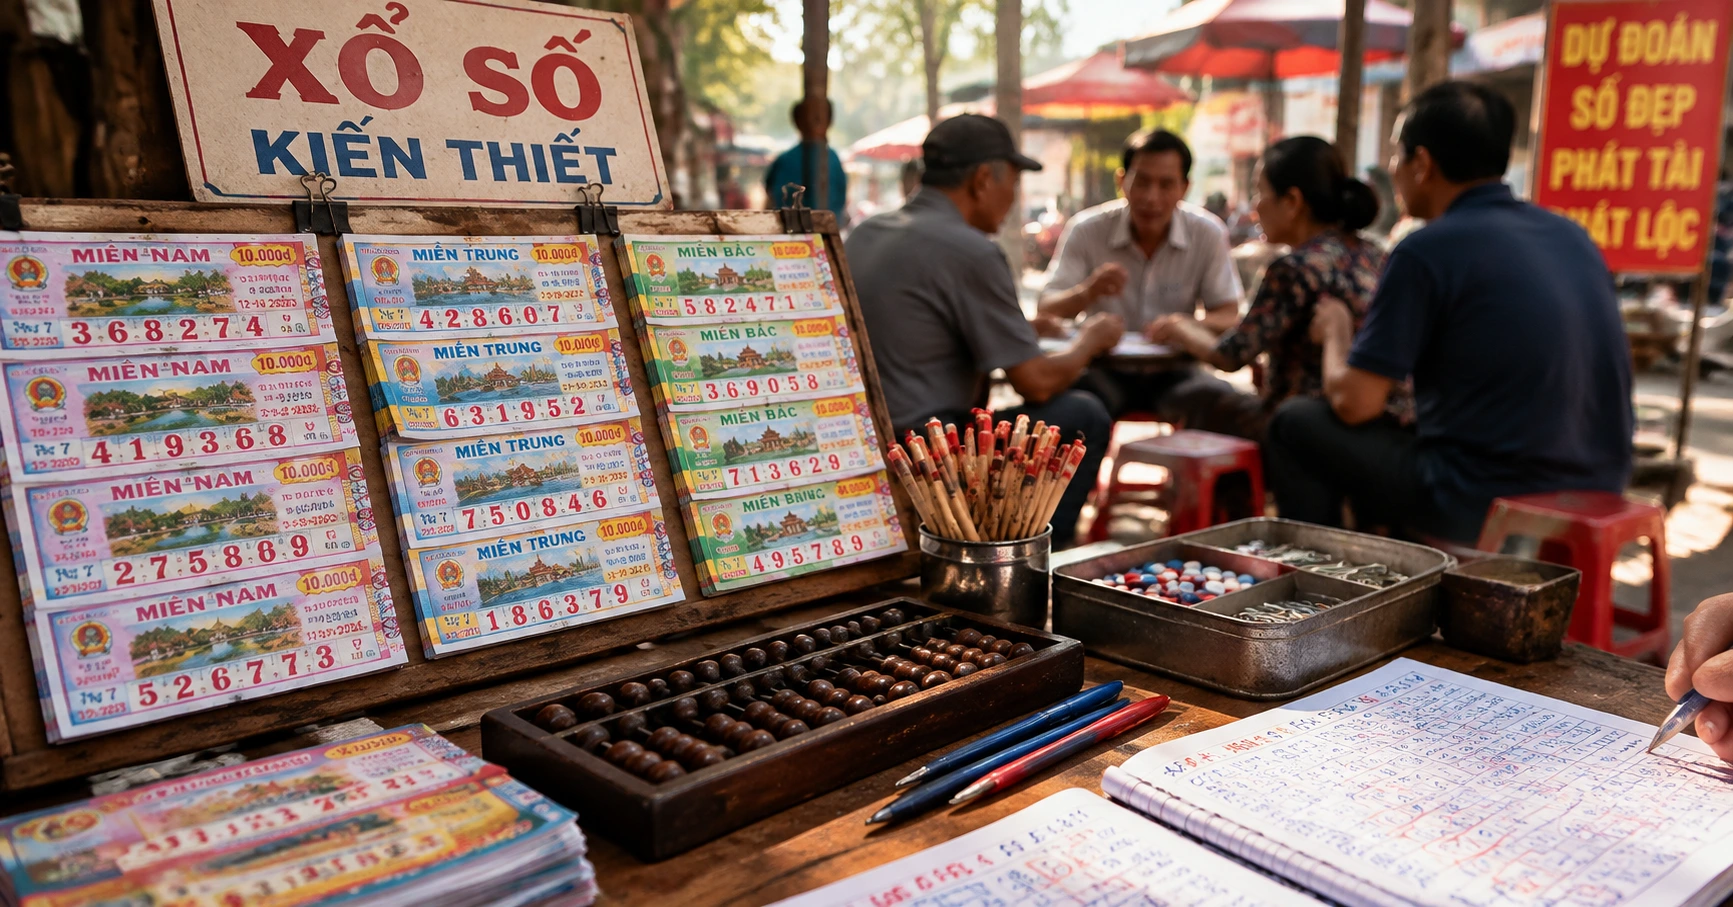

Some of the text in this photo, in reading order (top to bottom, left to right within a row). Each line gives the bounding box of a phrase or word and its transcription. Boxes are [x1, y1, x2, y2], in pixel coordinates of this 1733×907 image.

[236, 2, 602, 121] XỔ SỐ
[251, 115, 617, 184] KIẾN THIẾT
[1549, 139, 1641, 191] PHÁT
[151, 247, 210, 263] NAM
[463, 249, 519, 261] TRUNG
[483, 341, 542, 356] TRUNG
[171, 359, 231, 375] NAM
[506, 435, 565, 451] TRUNG
[195, 471, 254, 490] NAM
[526, 530, 586, 551] TRUNG
[216, 583, 277, 607] NAM
